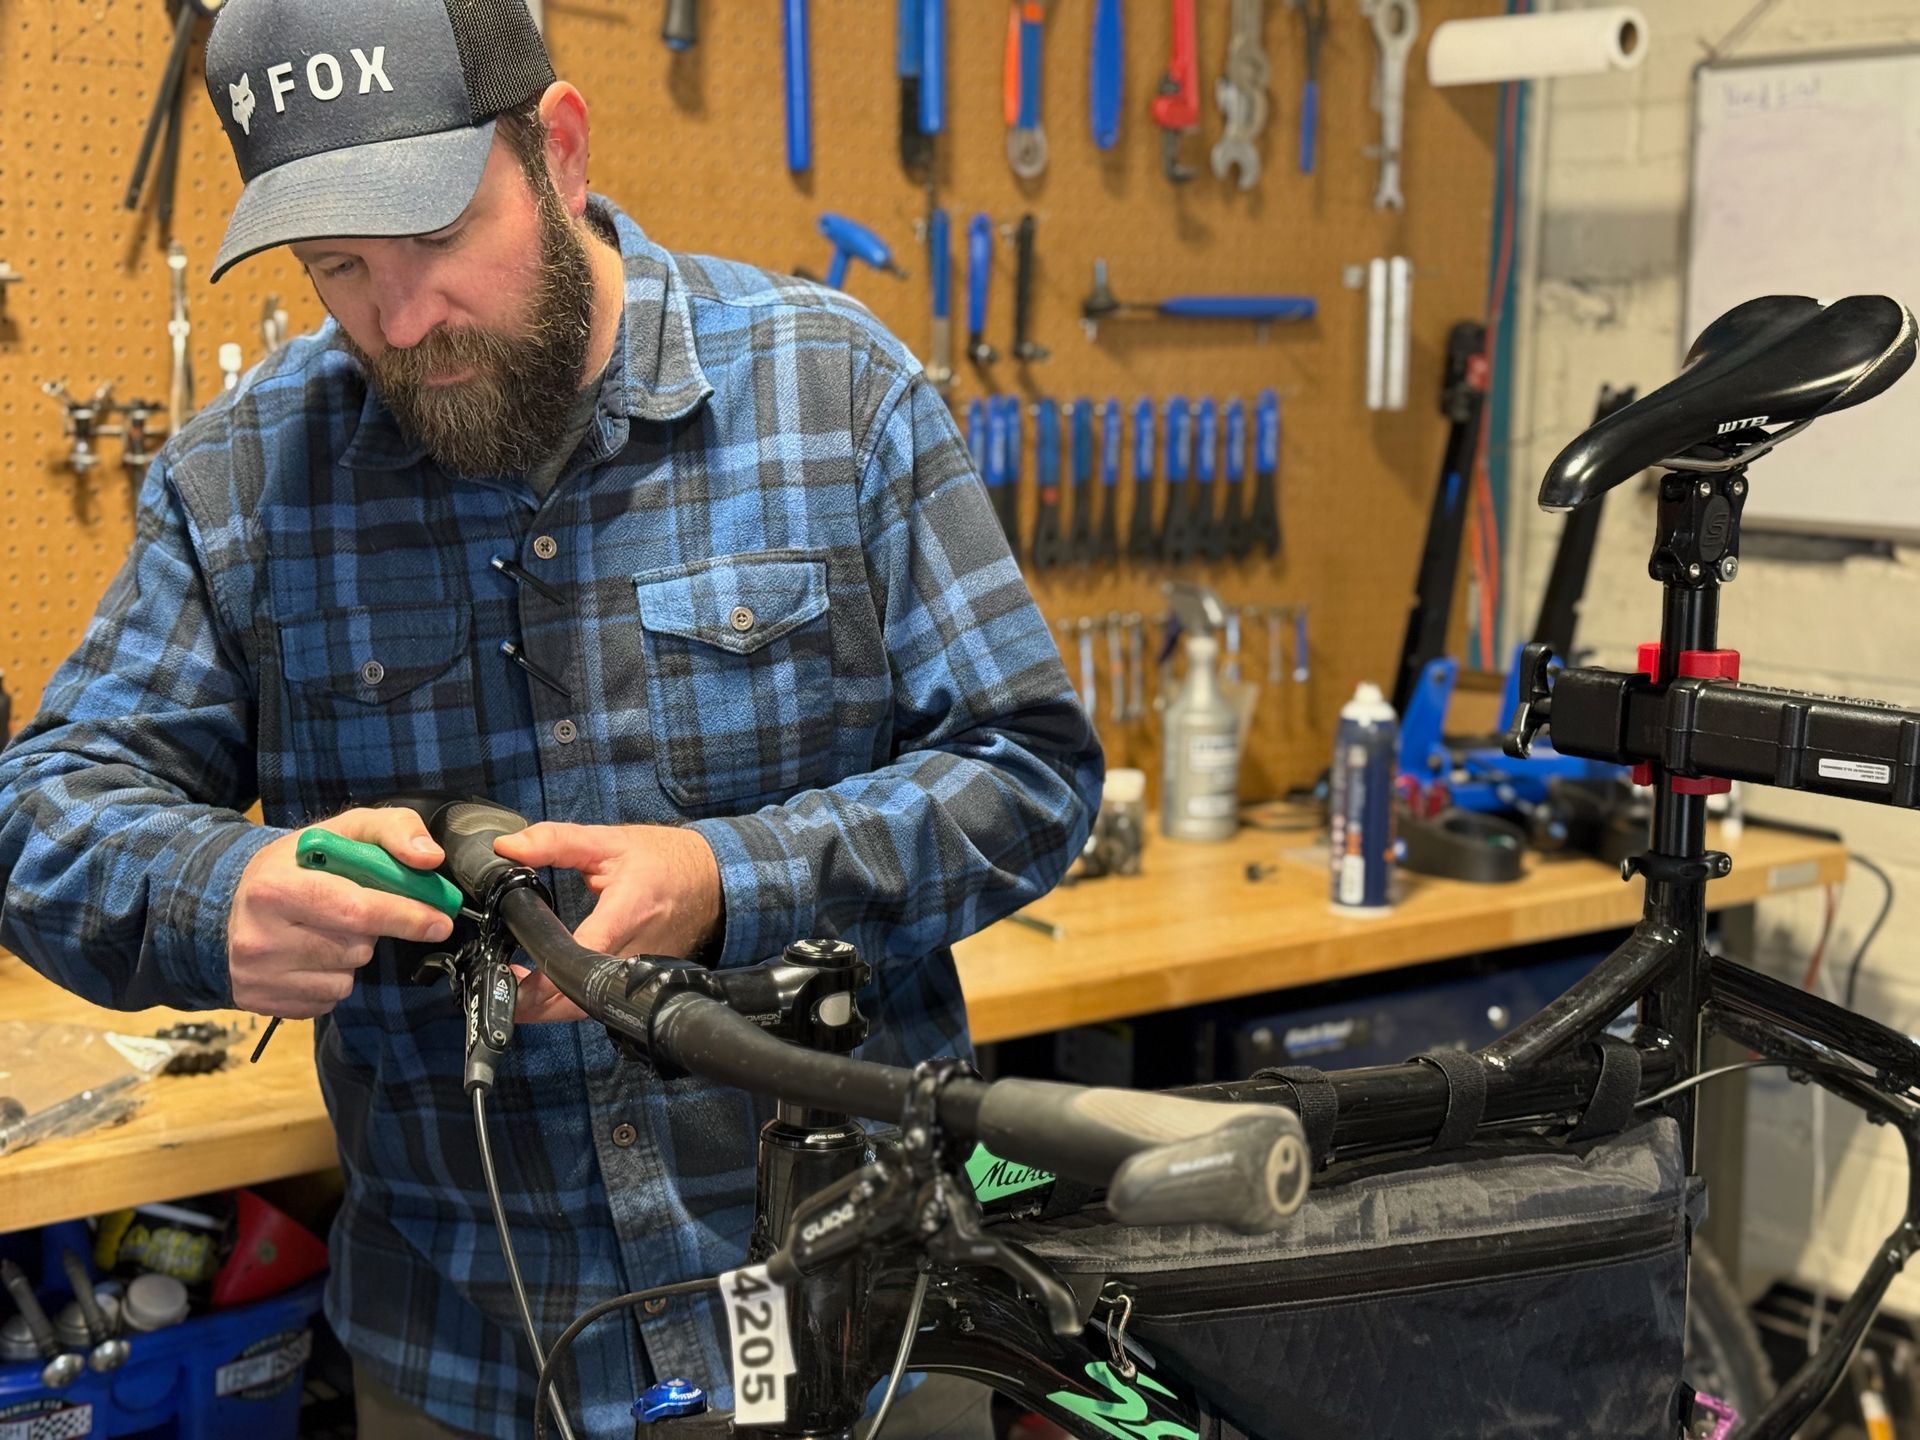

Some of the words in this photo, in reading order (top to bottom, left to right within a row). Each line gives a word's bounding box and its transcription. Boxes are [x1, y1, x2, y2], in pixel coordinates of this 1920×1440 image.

[268, 46, 393, 113] FOX
[1718, 416, 1769, 434] WTB
[730, 1270, 776, 1406] 4205
